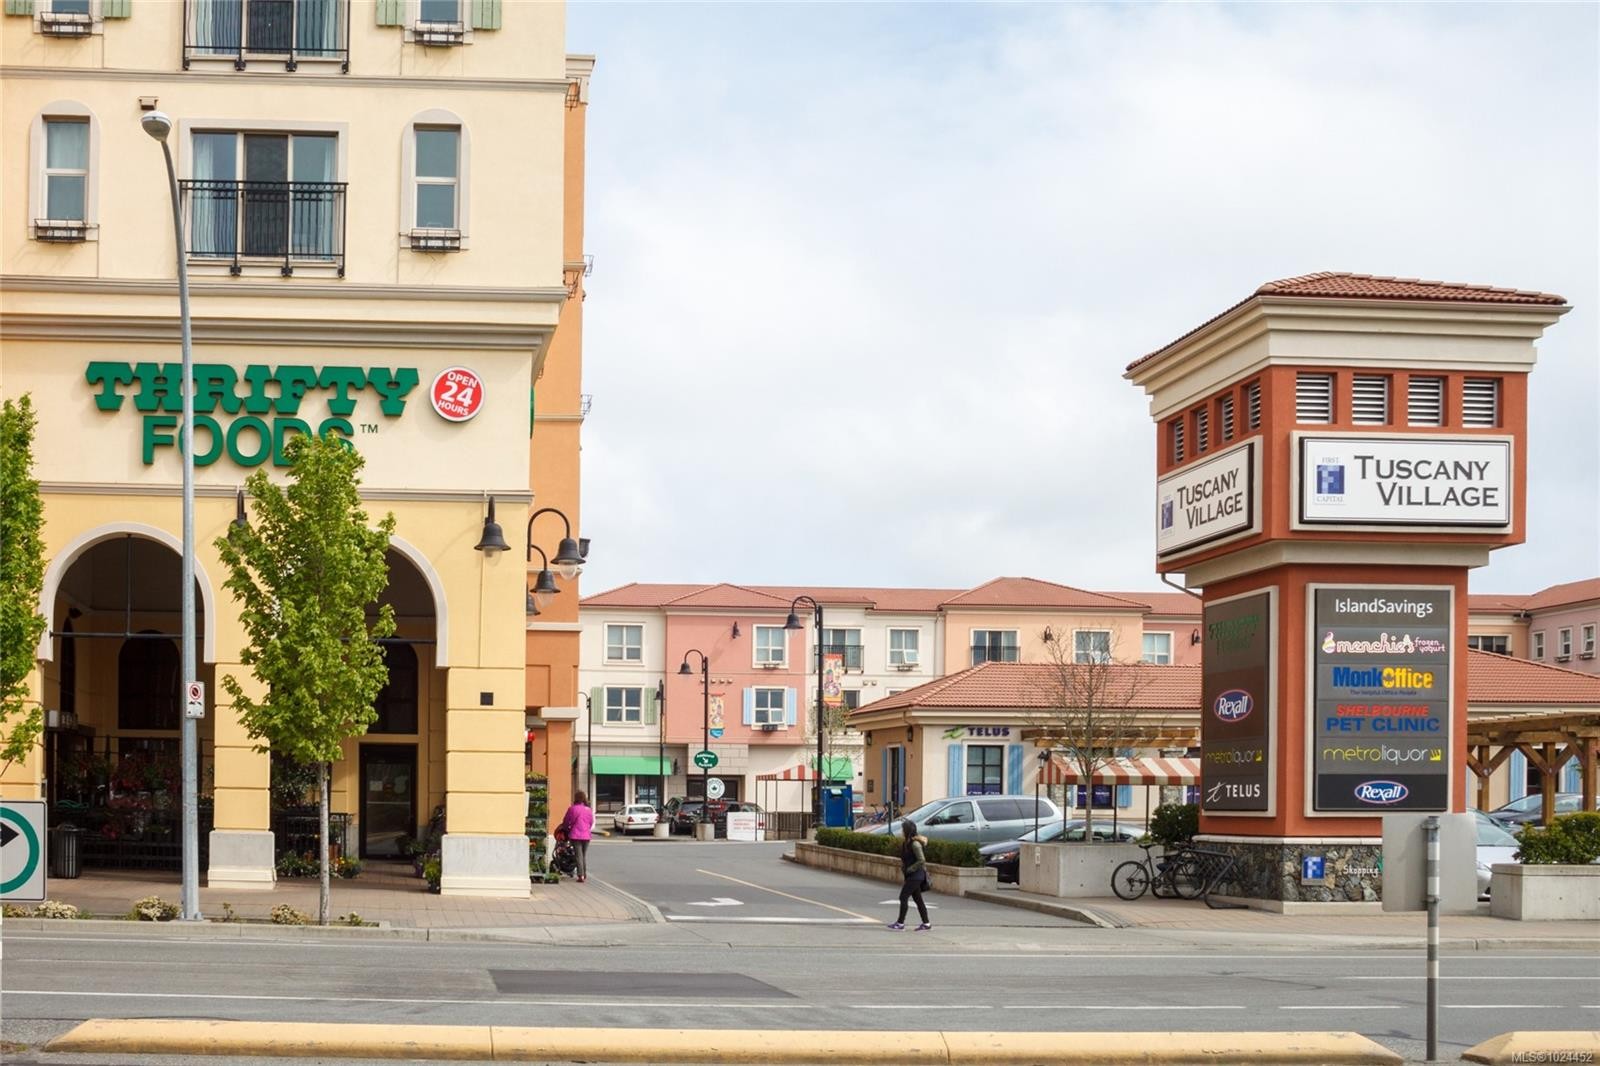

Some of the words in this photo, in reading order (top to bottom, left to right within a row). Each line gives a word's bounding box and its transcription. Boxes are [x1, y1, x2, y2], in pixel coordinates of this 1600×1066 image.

[85, 361, 419, 417] THRIFTY
[447, 371, 478, 389] OPEN
[440, 380, 474, 407] 24
[438, 400, 470, 416] HOURS
[1377, 482, 1499, 507] VILLAGE
[1186, 492, 1243, 529] VILLAGE
[1335, 599, 1433, 618] IslandSavings
[1332, 666, 1434, 688] MonkOffice
[1218, 696, 1248, 718] Rexall
[1337, 704, 1429, 717] SHELBOURNE
[968, 727, 1010, 737] TELUS
[1326, 717, 1365, 731] PET
[1372, 717, 1440, 732] CLINIC
[1323, 744, 1428, 765] metroliquor
[1226, 783, 1261, 798] TELUS
[1361, 785, 1401, 801] Rexall
